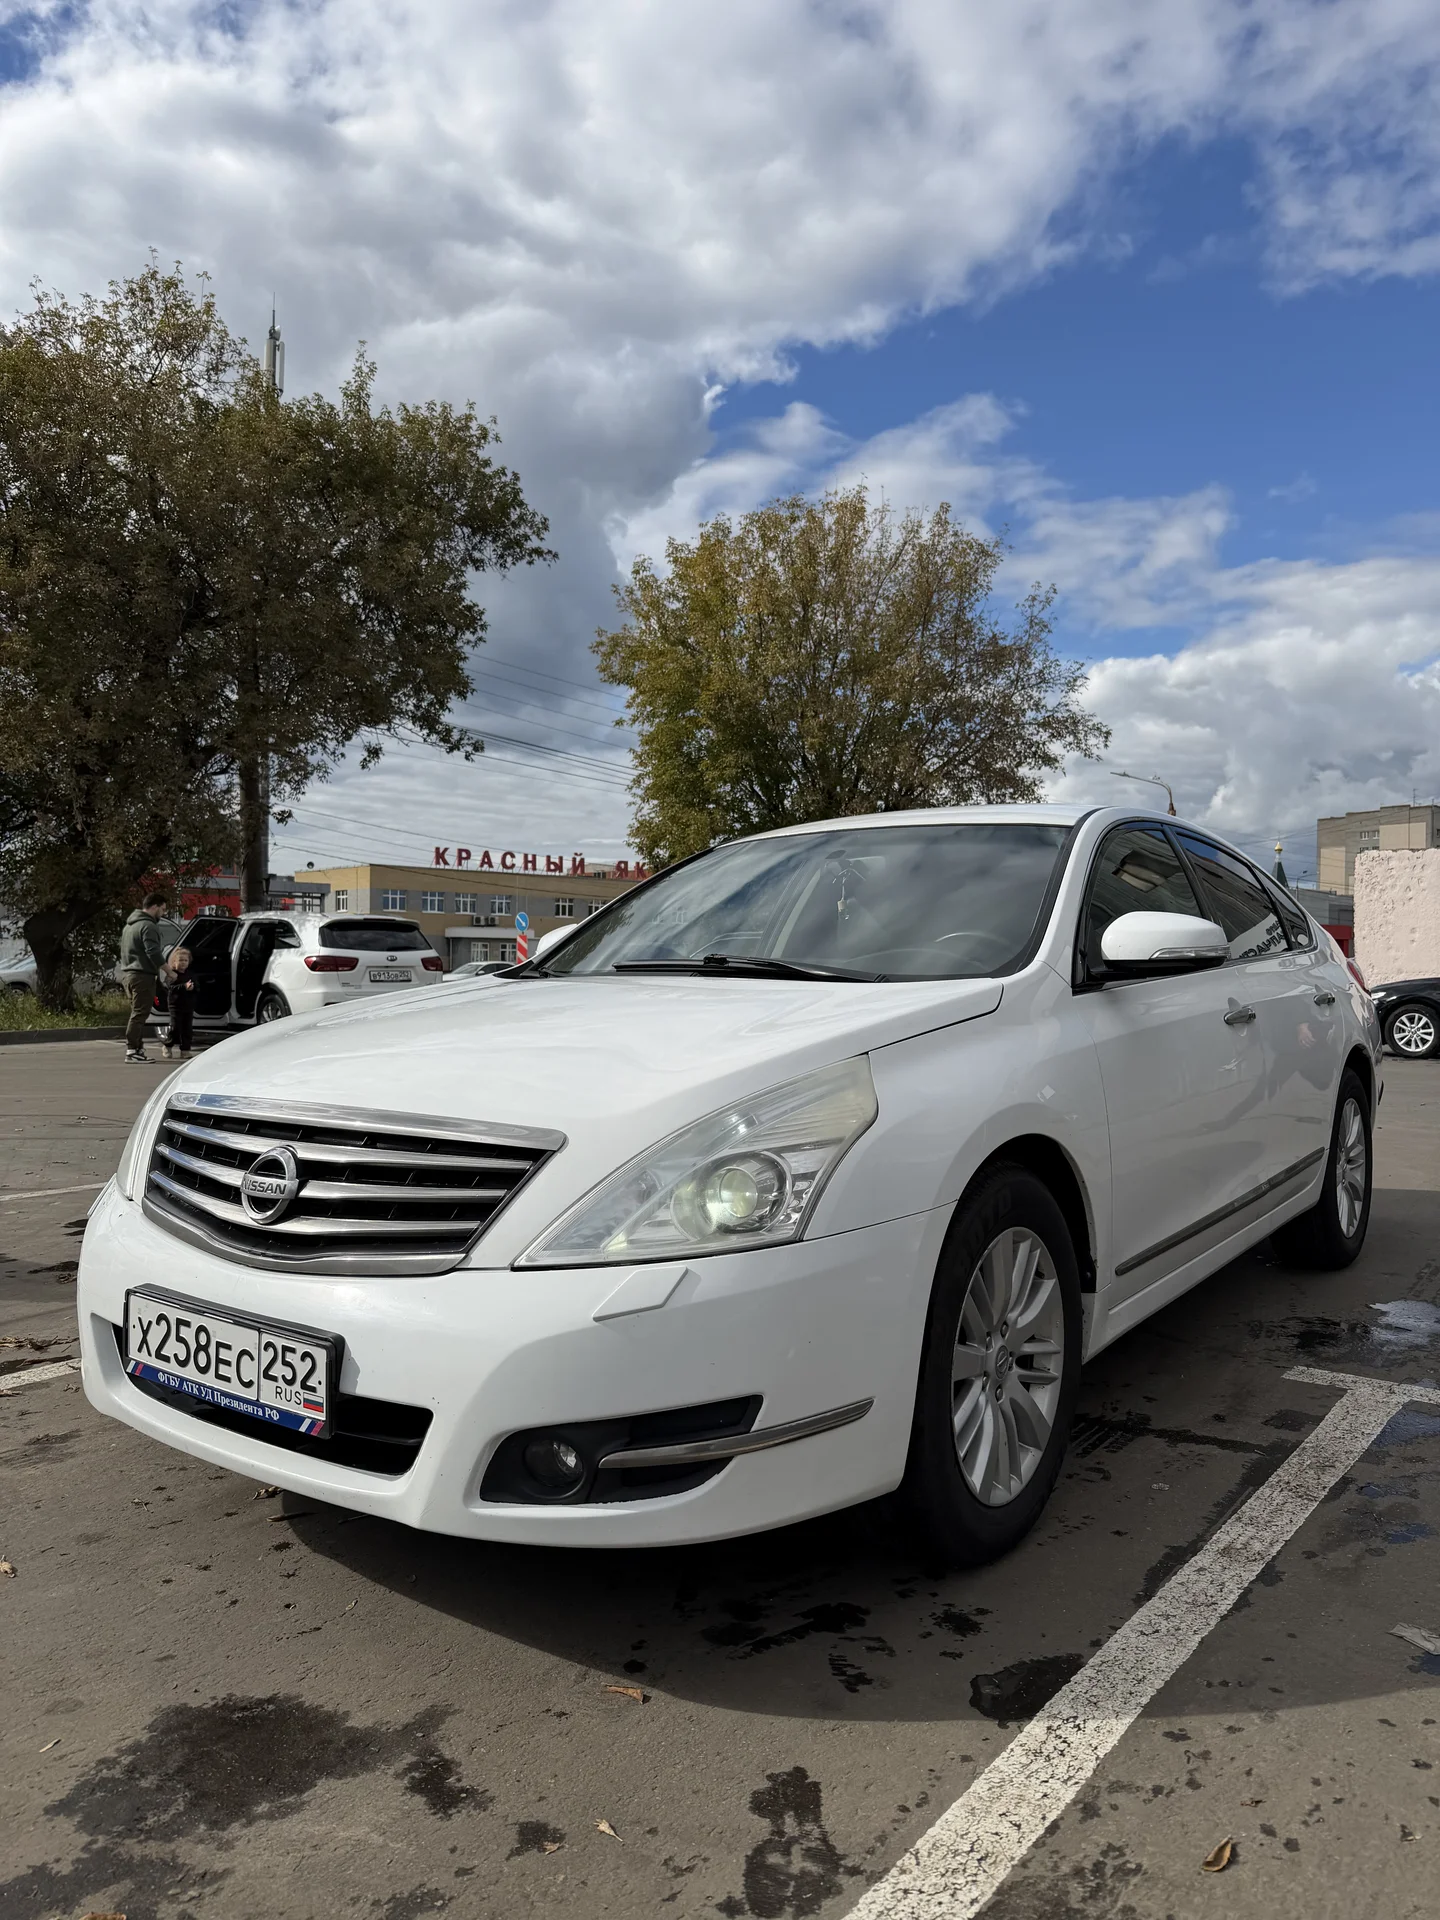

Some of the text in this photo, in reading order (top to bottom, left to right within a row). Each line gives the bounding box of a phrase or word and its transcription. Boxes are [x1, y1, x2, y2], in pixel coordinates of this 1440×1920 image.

[434, 847, 585, 875] КРАСНЫЙ
[243, 1179, 287, 1195] NISSAN
[137, 1313, 317, 1394] Х258ЕС 252
[157, 1371, 280, 1421] ФГБУ АТК УД Президента РФ
[275, 1386, 302, 1406] RUS
